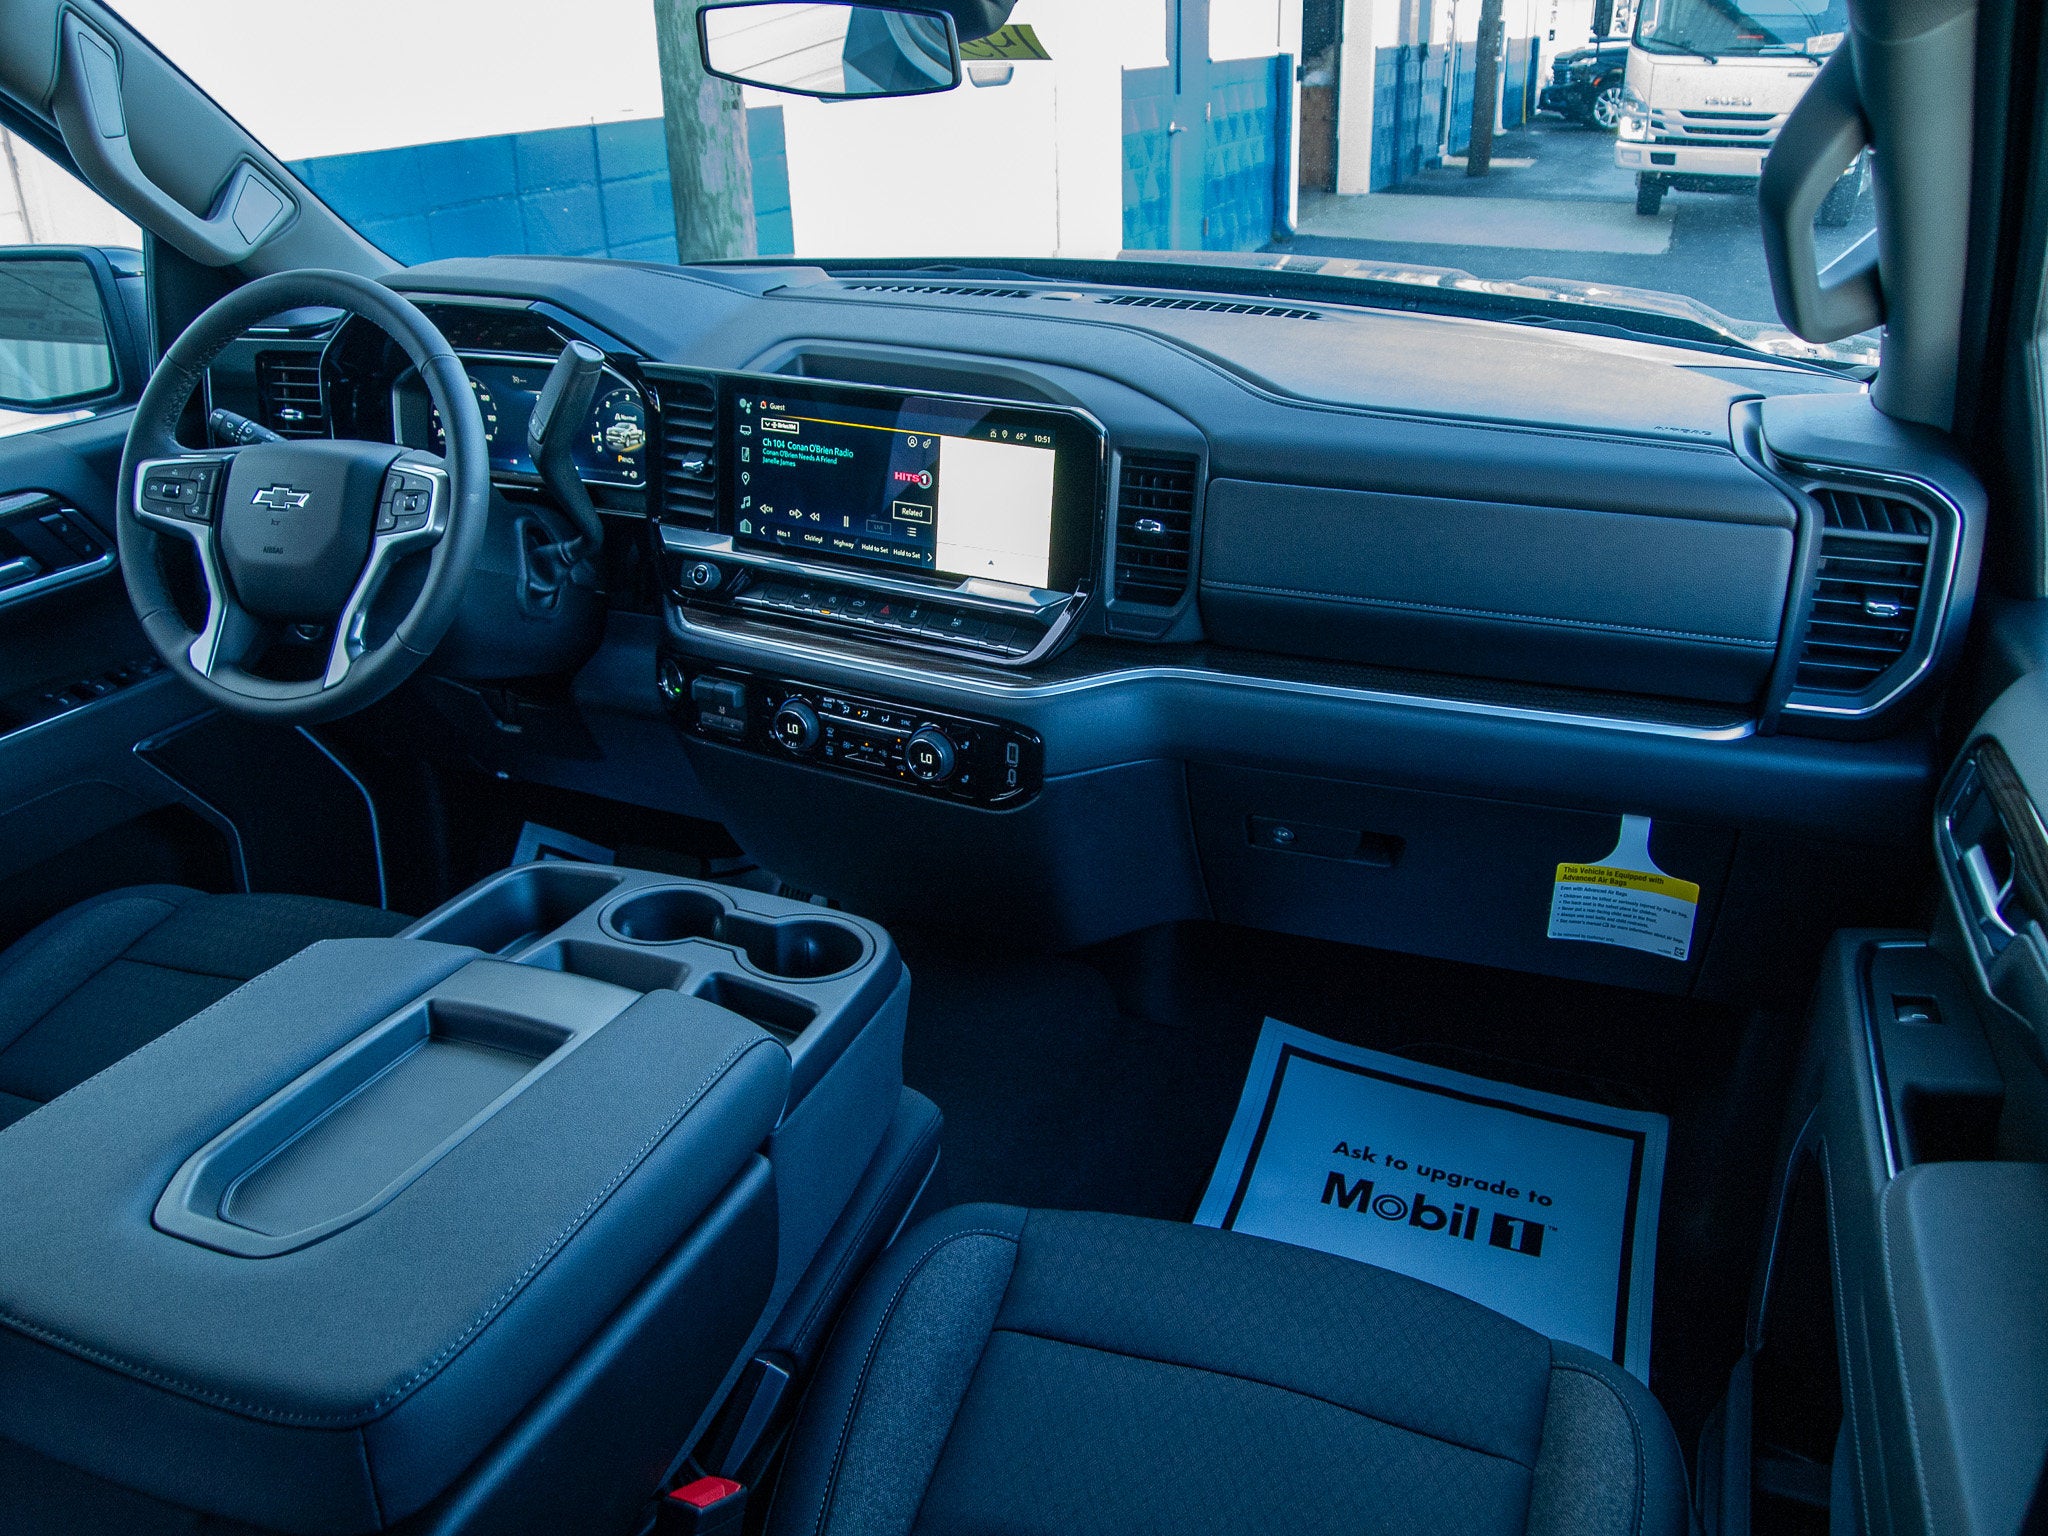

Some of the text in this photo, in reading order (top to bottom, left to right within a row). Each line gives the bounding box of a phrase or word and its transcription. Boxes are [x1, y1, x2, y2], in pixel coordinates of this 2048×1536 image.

[1705, 96, 1752, 105] ISUZU
[769, 403, 785, 411] Guest
[1034, 434, 1051, 444] 10:51
[762, 438, 854, 458] Ch 104 Conan O'Brien Radio
[762, 448, 779, 456] Conan
[779, 451, 798, 459] O'Brien
[799, 453, 815, 462] Needs
[762, 457, 796, 467] Janelle James
[901, 507, 923, 518] Related
[776, 529, 786, 537] Hits
[833, 539, 854, 549] Highway
[861, 543, 873, 551] Hold
[893, 549, 904, 557] Hold
[912, 551, 920, 559] Set
[787, 723, 799, 735] LO
[920, 752, 933, 765] LO
[1562, 874, 1597, 882] Advanced
[1610, 878, 1627, 887] Bags
[1614, 871, 1647, 882] Equipped
[1649, 876, 1664, 885] with
[1332, 1141, 1553, 1207] Ask to upgrade to
[1321, 1170, 1481, 1241] Mobil
